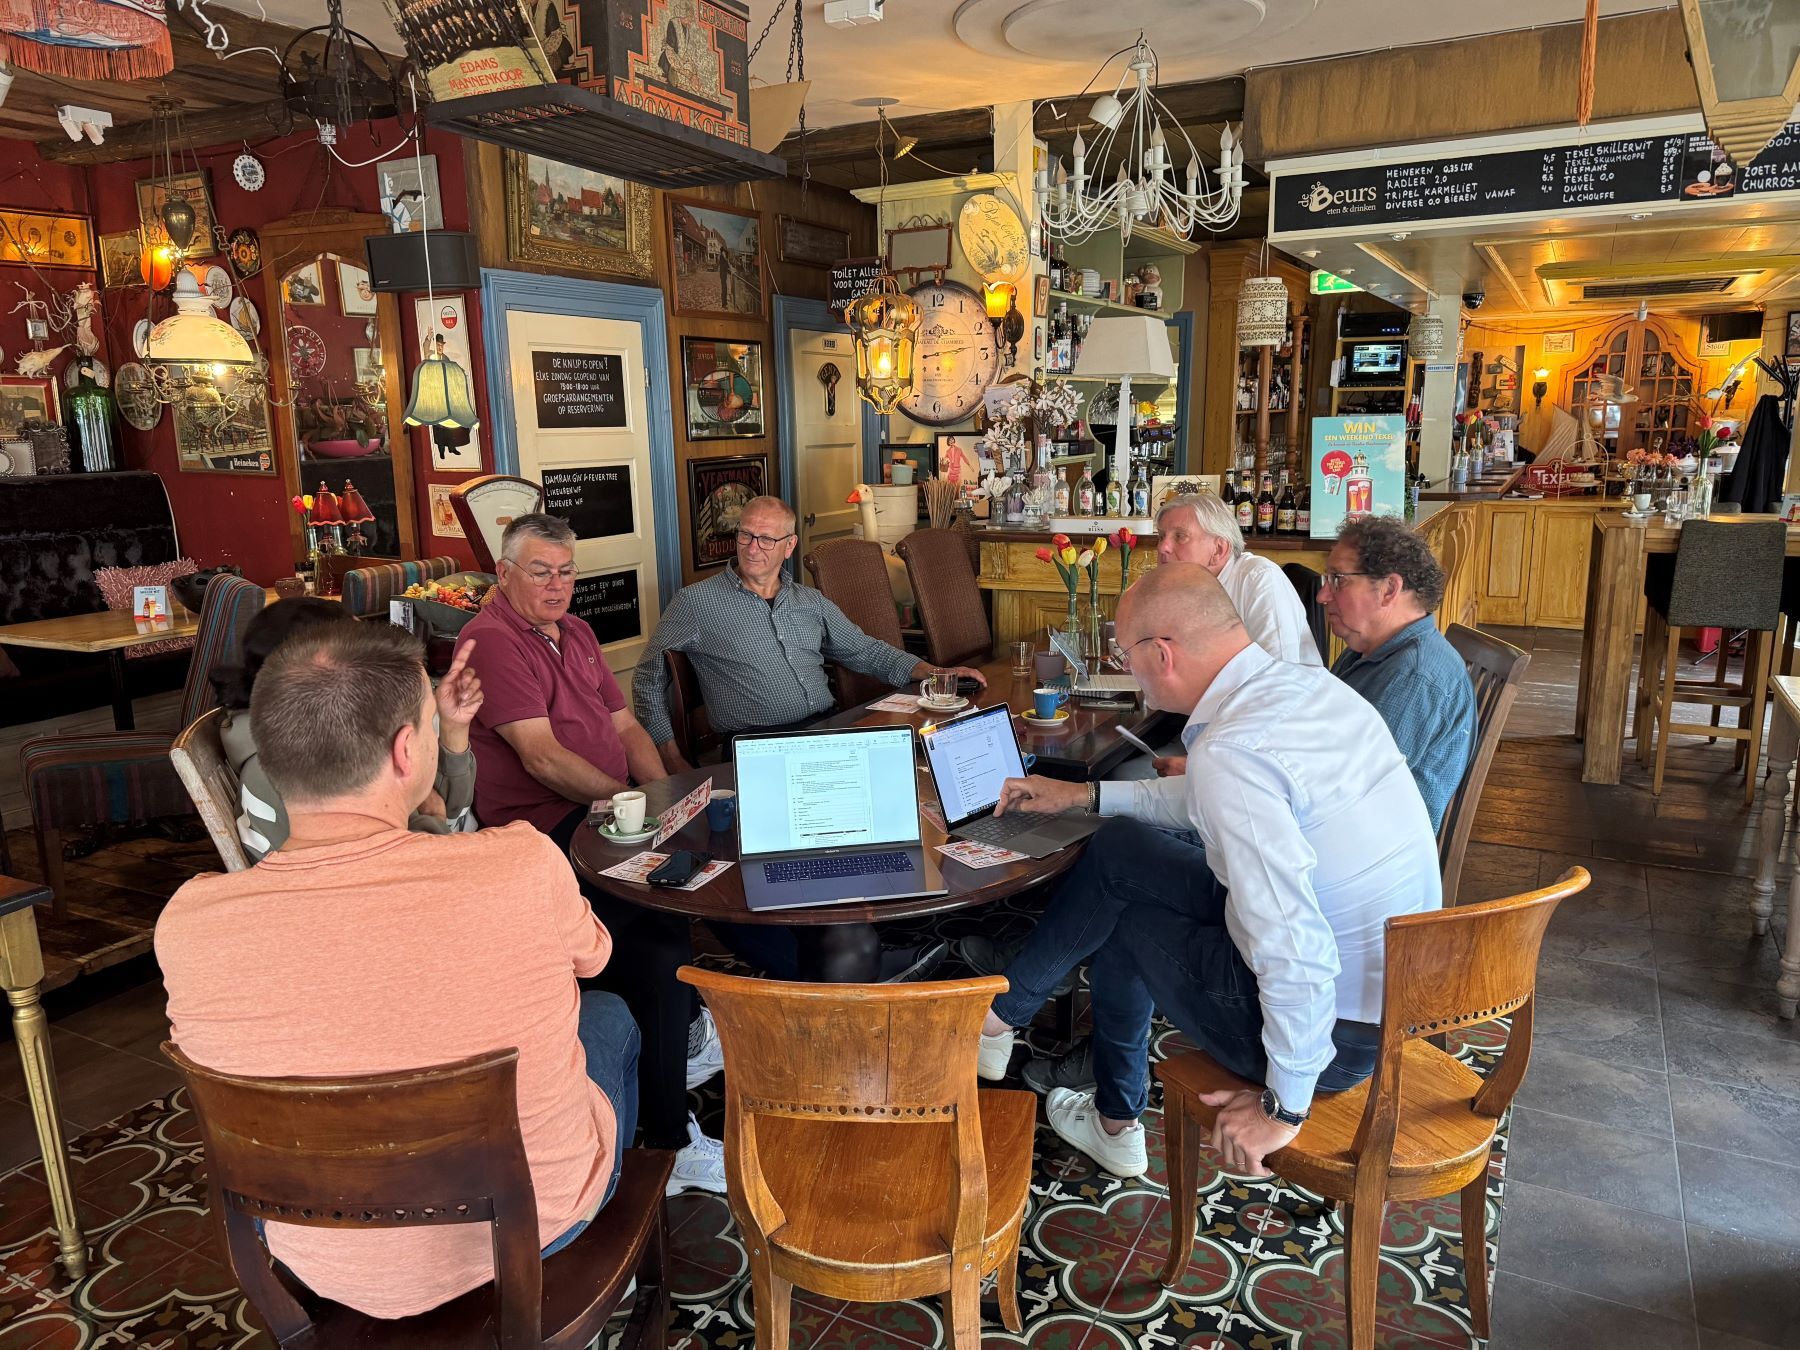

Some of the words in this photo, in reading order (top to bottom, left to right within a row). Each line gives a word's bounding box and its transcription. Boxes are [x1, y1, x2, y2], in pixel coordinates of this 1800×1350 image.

[459, 57, 499, 74] EDAMS
[449, 68, 524, 91] MANNENKOOR
[615, 80, 684, 125] AROMA
[689, 110, 750, 147] KOFFIE
[1565, 146, 1594, 158] TEXEL
[1564, 158, 1591, 167] TEXEL
[1593, 151, 1646, 163] SKUUMKOPPE
[1460, 162, 1474, 172] LTR
[1744, 164, 1777, 177] ZOETE
[1387, 177, 1426, 190] RADLER
[1563, 174, 1595, 184] TEXEL
[1563, 183, 1594, 193] DUVEL
[1309, 183, 1377, 213] Beurs
[1485, 189, 1516, 200] VANAF
[1562, 194, 1575, 203] LA
[1577, 191, 1615, 202] CHOUFFE
[1326, 207, 1341, 215] eten
[1342, 206, 1349, 214] &
[1350, 203, 1377, 213] drinken
[834, 280, 852, 288] VOOR
[932, 293, 945, 307] 12
[958, 299, 964, 313] 1
[974, 321, 983, 335] 2
[980, 347, 989, 360] 3
[552, 358, 561, 368] DE
[551, 373, 572, 381] ZONDAG
[573, 373, 597, 381] GEOPEND
[599, 373, 610, 382] VAN
[968, 372, 982, 385] 4
[913, 394, 920, 407] 7
[956, 395, 963, 407] 5
[557, 406, 566, 415] OP
[932, 401, 941, 414] 6
[1343, 422, 1376, 433] WIN
[588, 473, 606, 482] FEVER
[606, 473, 618, 481] TREE
[548, 498, 573, 508] JENEVER
